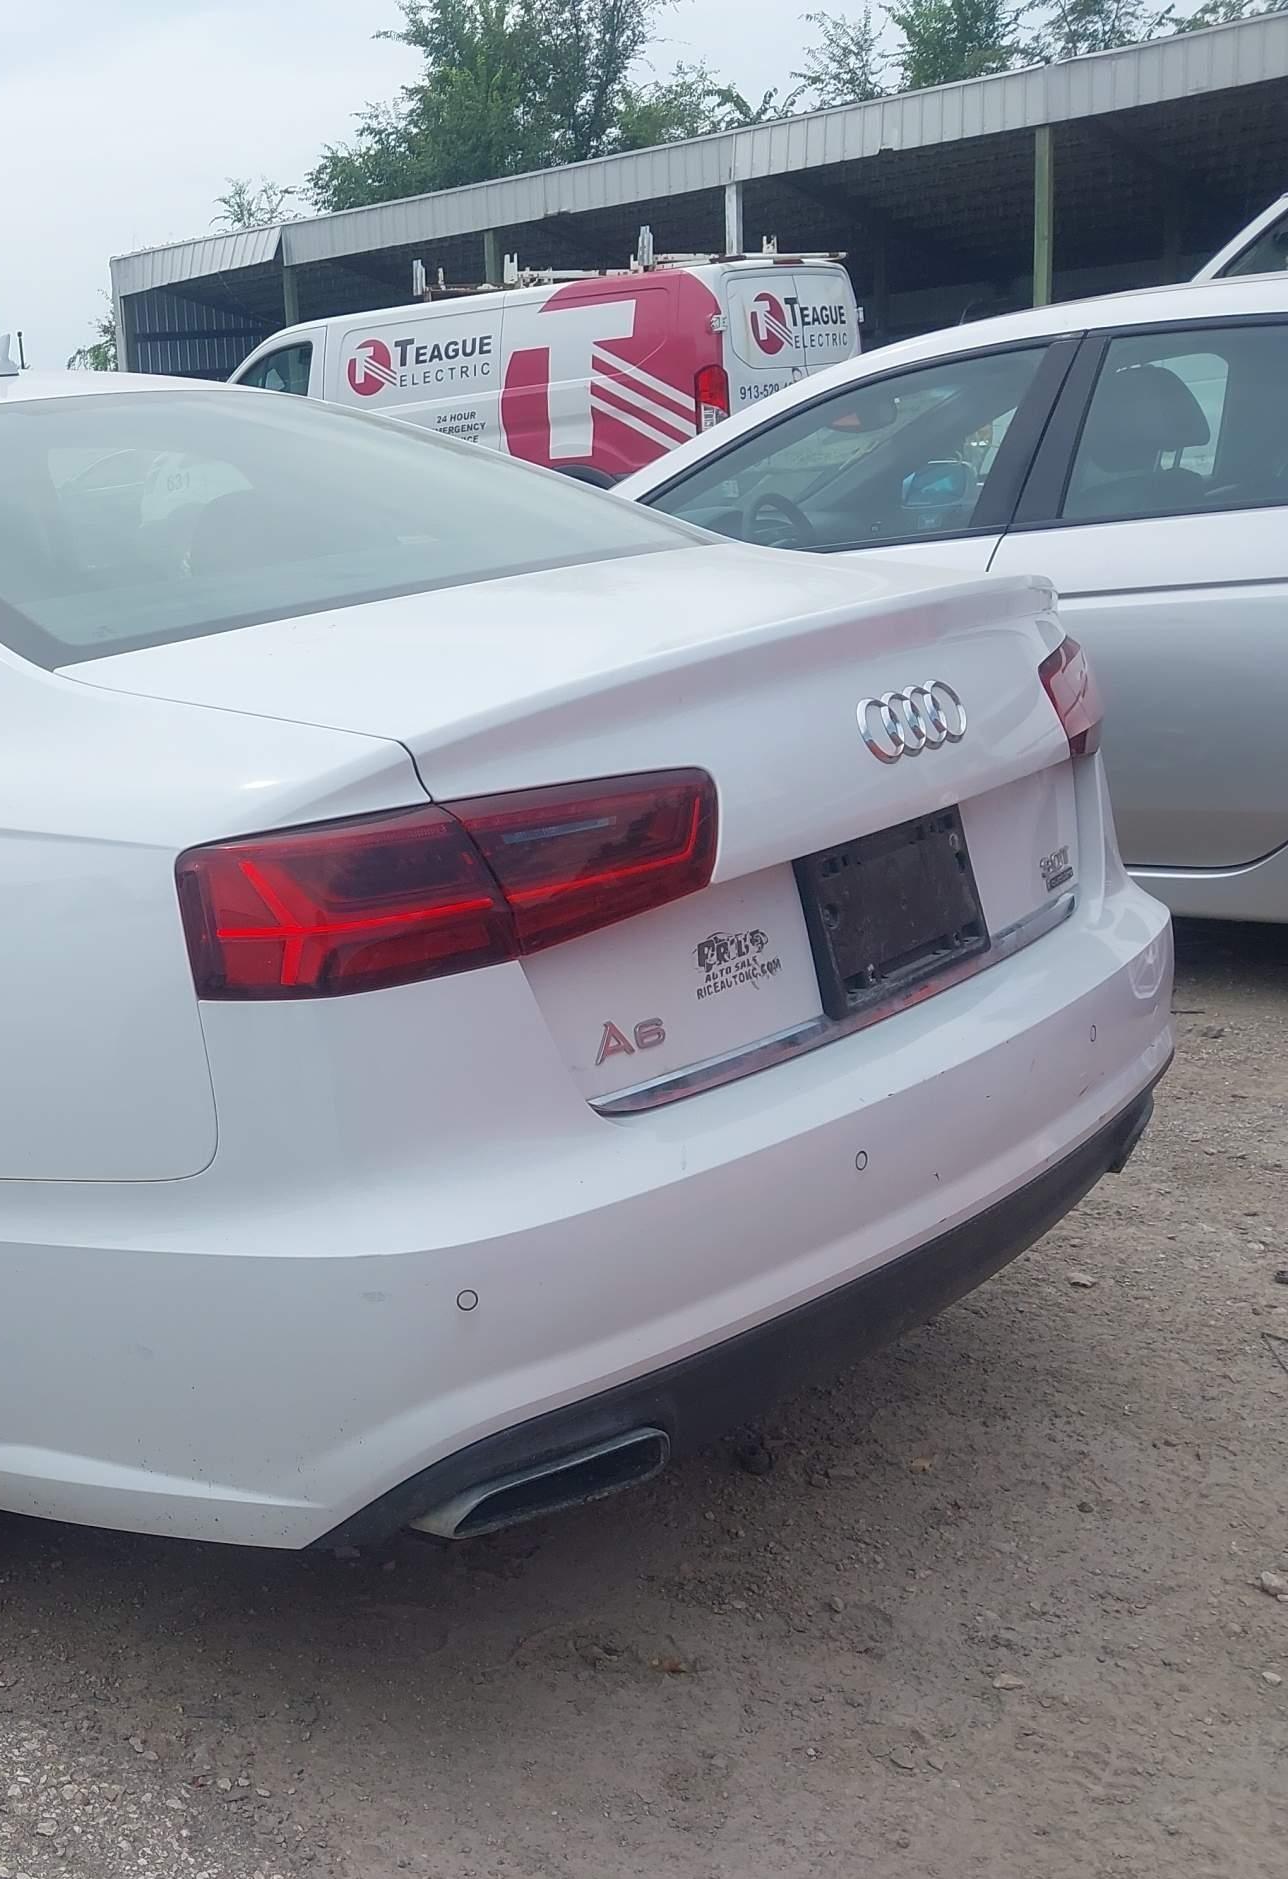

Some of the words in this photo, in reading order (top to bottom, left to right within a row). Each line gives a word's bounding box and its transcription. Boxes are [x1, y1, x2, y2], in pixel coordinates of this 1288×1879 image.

[784, 297, 846, 327] TEAGUE
[794, 332, 848, 349] ELECTRIC
[394, 335, 492, 367] TEAGUE
[399, 362, 491, 387] ELECTRIC
[437, 415, 448, 424] 24
[449, 411, 476, 423] HOUR
[432, 422, 486, 435] MERGENCY
[167, 471, 190, 491] 631
[705, 966, 732, 983] AUTO
[595, 1017, 666, 1066] A6
